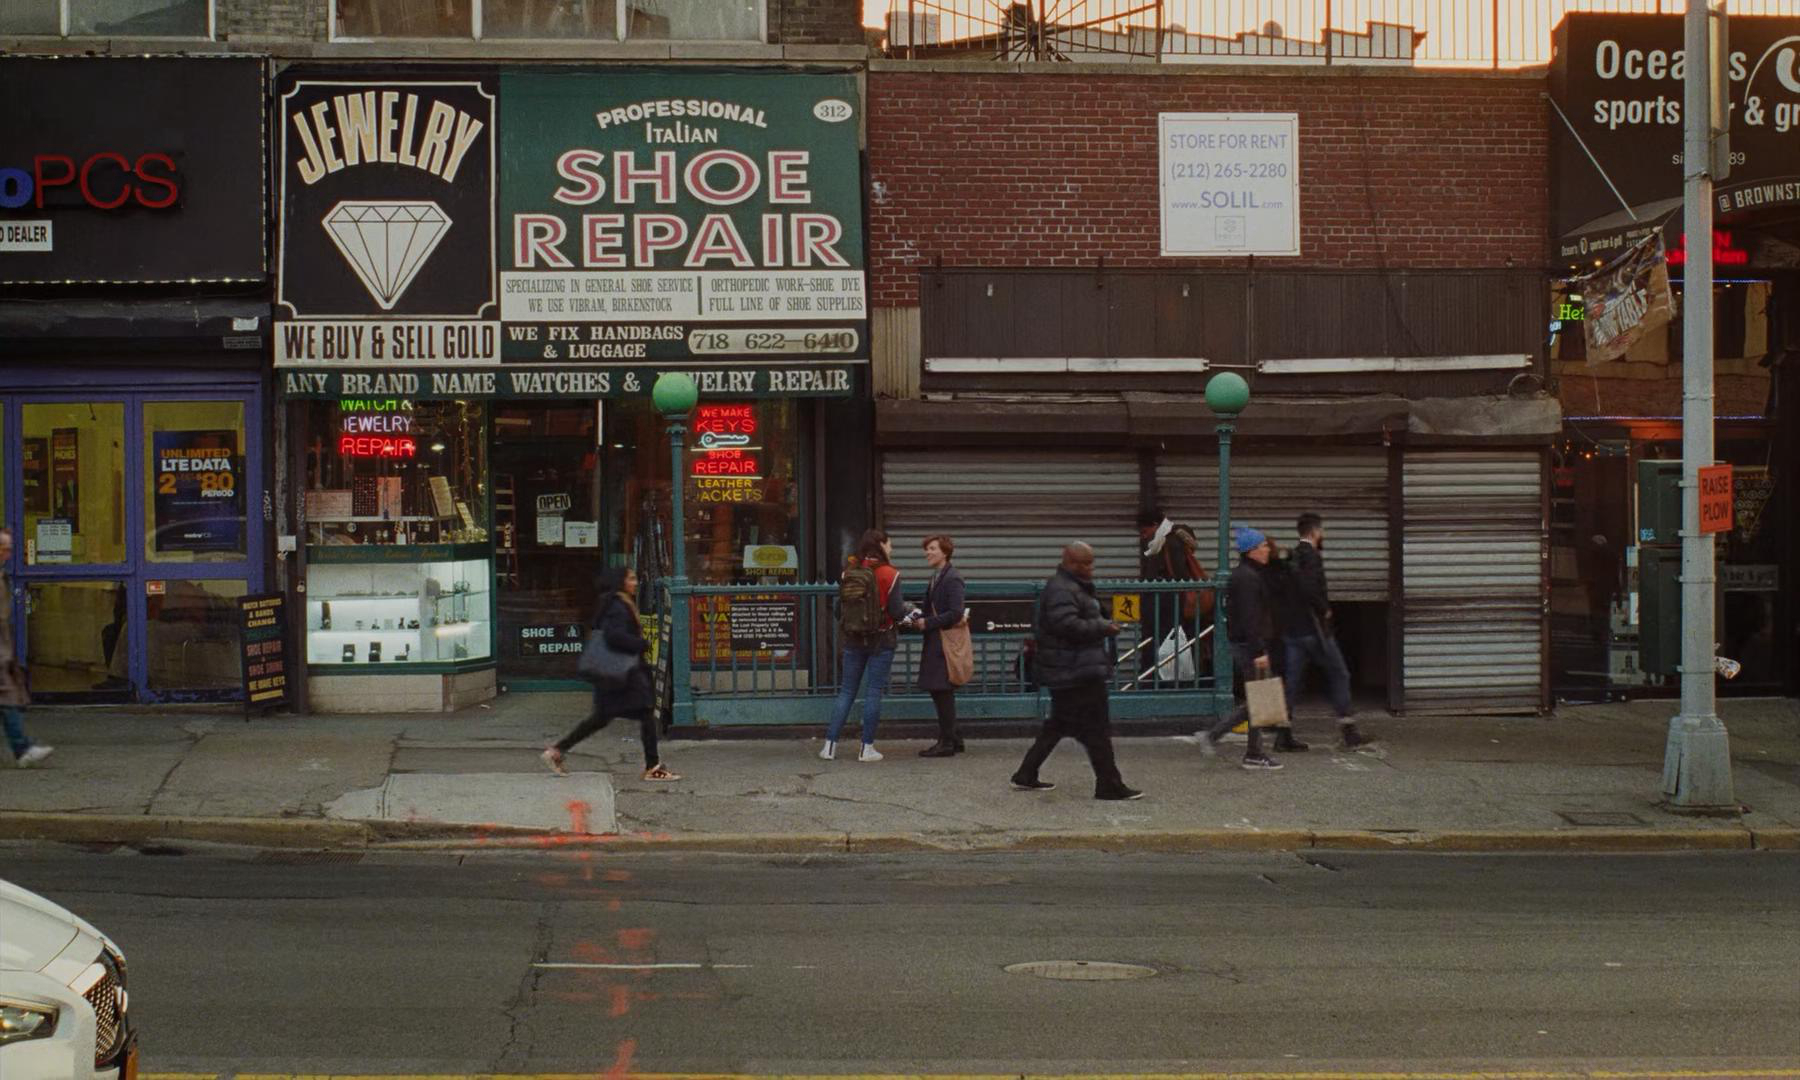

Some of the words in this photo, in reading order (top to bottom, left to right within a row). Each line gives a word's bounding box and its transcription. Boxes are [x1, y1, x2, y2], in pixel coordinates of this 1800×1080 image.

[596, 100, 768, 130] PROFESSIONAL
[819, 105, 847, 118] 312
[1594, 96, 1680, 130] sports
[1744, 96, 1764, 125] &
[293, 91, 484, 185] JEWELRY
[1170, 134, 1216, 149] STORE
[1219, 134, 1247, 149] FOR
[1251, 134, 1288, 149] RENT
[553, 150, 811, 205] SHOE
[1171, 162, 1211, 181] (212)
[1214, 163, 1287, 178] 265-2280
[1718, 194, 1732, 212] @
[8, 226, 47, 242] DEALER
[514, 214, 850, 268] REPAIR
[505, 278, 565, 293] SPECIALIZING
[570, 278, 581, 293] IN
[585, 278, 625, 293] GENERAL
[631, 278, 652, 293] SHOE
[657, 278, 693, 293] SERVICE
[711, 278, 770, 293] ORTHOPEDIC
[841, 277, 860, 292] DYE
[528, 298, 543, 313] WE
[548, 298, 564, 313] USE
[569, 298, 608, 314] VIBRAM,
[612, 297, 673, 312] BIRKENSTOCK
[709, 297, 735, 312] FULL
[740, 297, 763, 311] LINE
[768, 297, 782, 311] OF
[786, 297, 811, 311] SHOE
[817, 296, 863, 311] SUPPLIES
[508, 326, 539, 341] WE
[548, 326, 580, 341] FIX
[590, 325, 684, 340] HANDBAGS
[284, 325, 316, 359] WE
[322, 325, 364, 359] BUY
[371, 325, 386, 359] &
[392, 325, 436, 360] SELL
[443, 324, 494, 359] GOLD
[693, 333, 730, 350] 718
[543, 344, 559, 359] &
[568, 344, 646, 358] LUGGAGE
[286, 373, 329, 394] ANY
[342, 373, 419, 395] BRAND
[432, 373, 496, 394] NAME
[511, 372, 611, 393] WATCHES
[623, 372, 641, 393] &
[768, 370, 850, 392] REPAIR
[340, 399, 397, 411] WATCH
[700, 408, 719, 417] WE
[720, 407, 750, 417] MAKE
[343, 415, 413, 433] JEWELRY
[696, 419, 755, 433] KEYS
[160, 448, 231, 459] UNLIMITED
[341, 437, 414, 457] REPAIR
[708, 450, 742, 459] SHOE
[161, 458, 189, 472] LTE
[191, 458, 232, 471] DATA
[695, 461, 756, 474] REPAIR
[159, 472, 177, 495] 2
[698, 479, 752, 488] LEATHER
[1702, 475, 1729, 497] RAISE
[201, 489, 234, 498] PERIOD
[697, 490, 763, 502] ACKETS
[539, 495, 569, 510] OPEN
[1702, 502, 1729, 521] PLOW
[247, 617, 276, 628] CHANGE
[521, 627, 555, 638] SHOE
[538, 642, 583, 654] REPAIR
